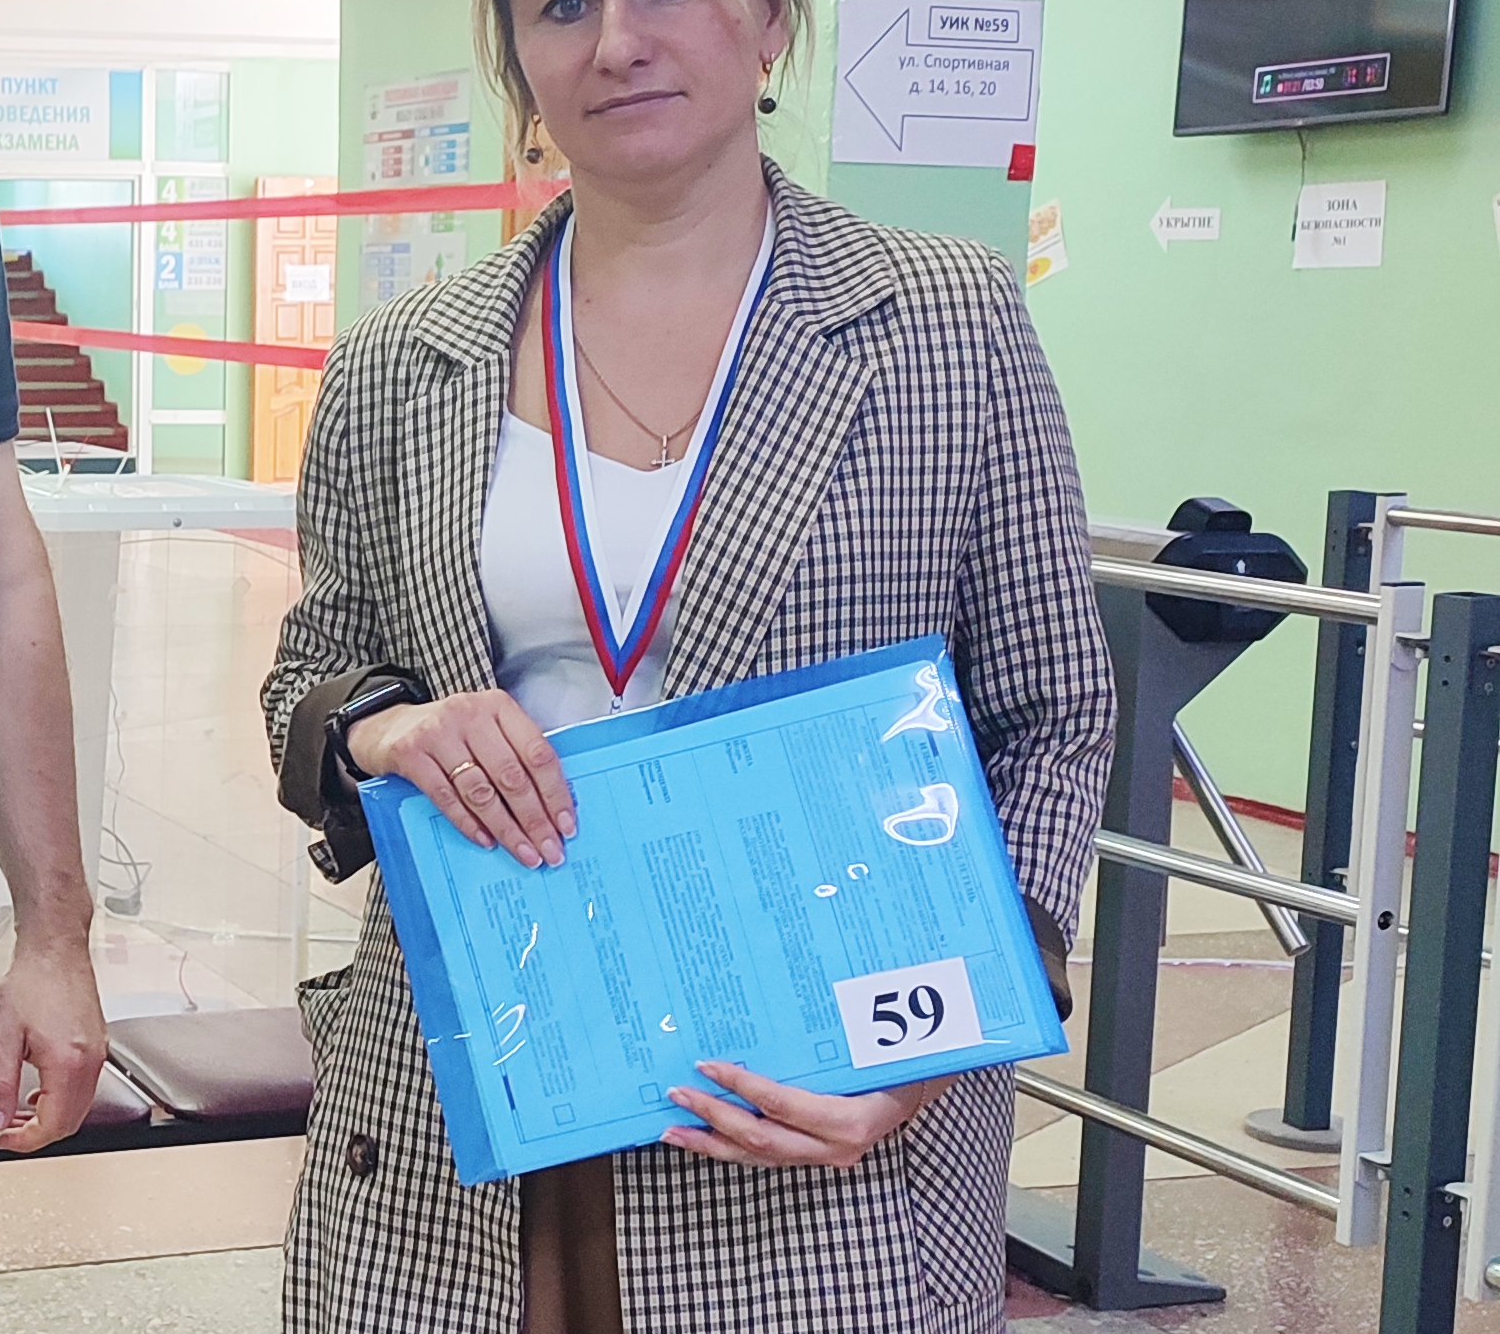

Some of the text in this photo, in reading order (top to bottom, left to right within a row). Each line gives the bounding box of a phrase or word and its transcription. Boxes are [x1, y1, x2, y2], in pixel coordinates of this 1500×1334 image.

[940, 15, 1009, 32] УИК №59
[899, 53, 1010, 72] ул. Спортивная
[1, 77, 58, 95] ПУНКТ
[929, 79, 949, 96] 14,
[954, 80, 974, 97] 16,
[979, 81, 997, 96] 20
[161, 179, 178, 203] 4
[1326, 198, 1358, 212] ЗОНА
[1158, 216, 1214, 229] УКРЫТИЕ
[1301, 217, 1382, 231] БЕЗОПАСНОСТИ
[161, 221, 177, 243] 4
[160, 255, 176, 280] 2
[872, 984, 944, 1047] 59
